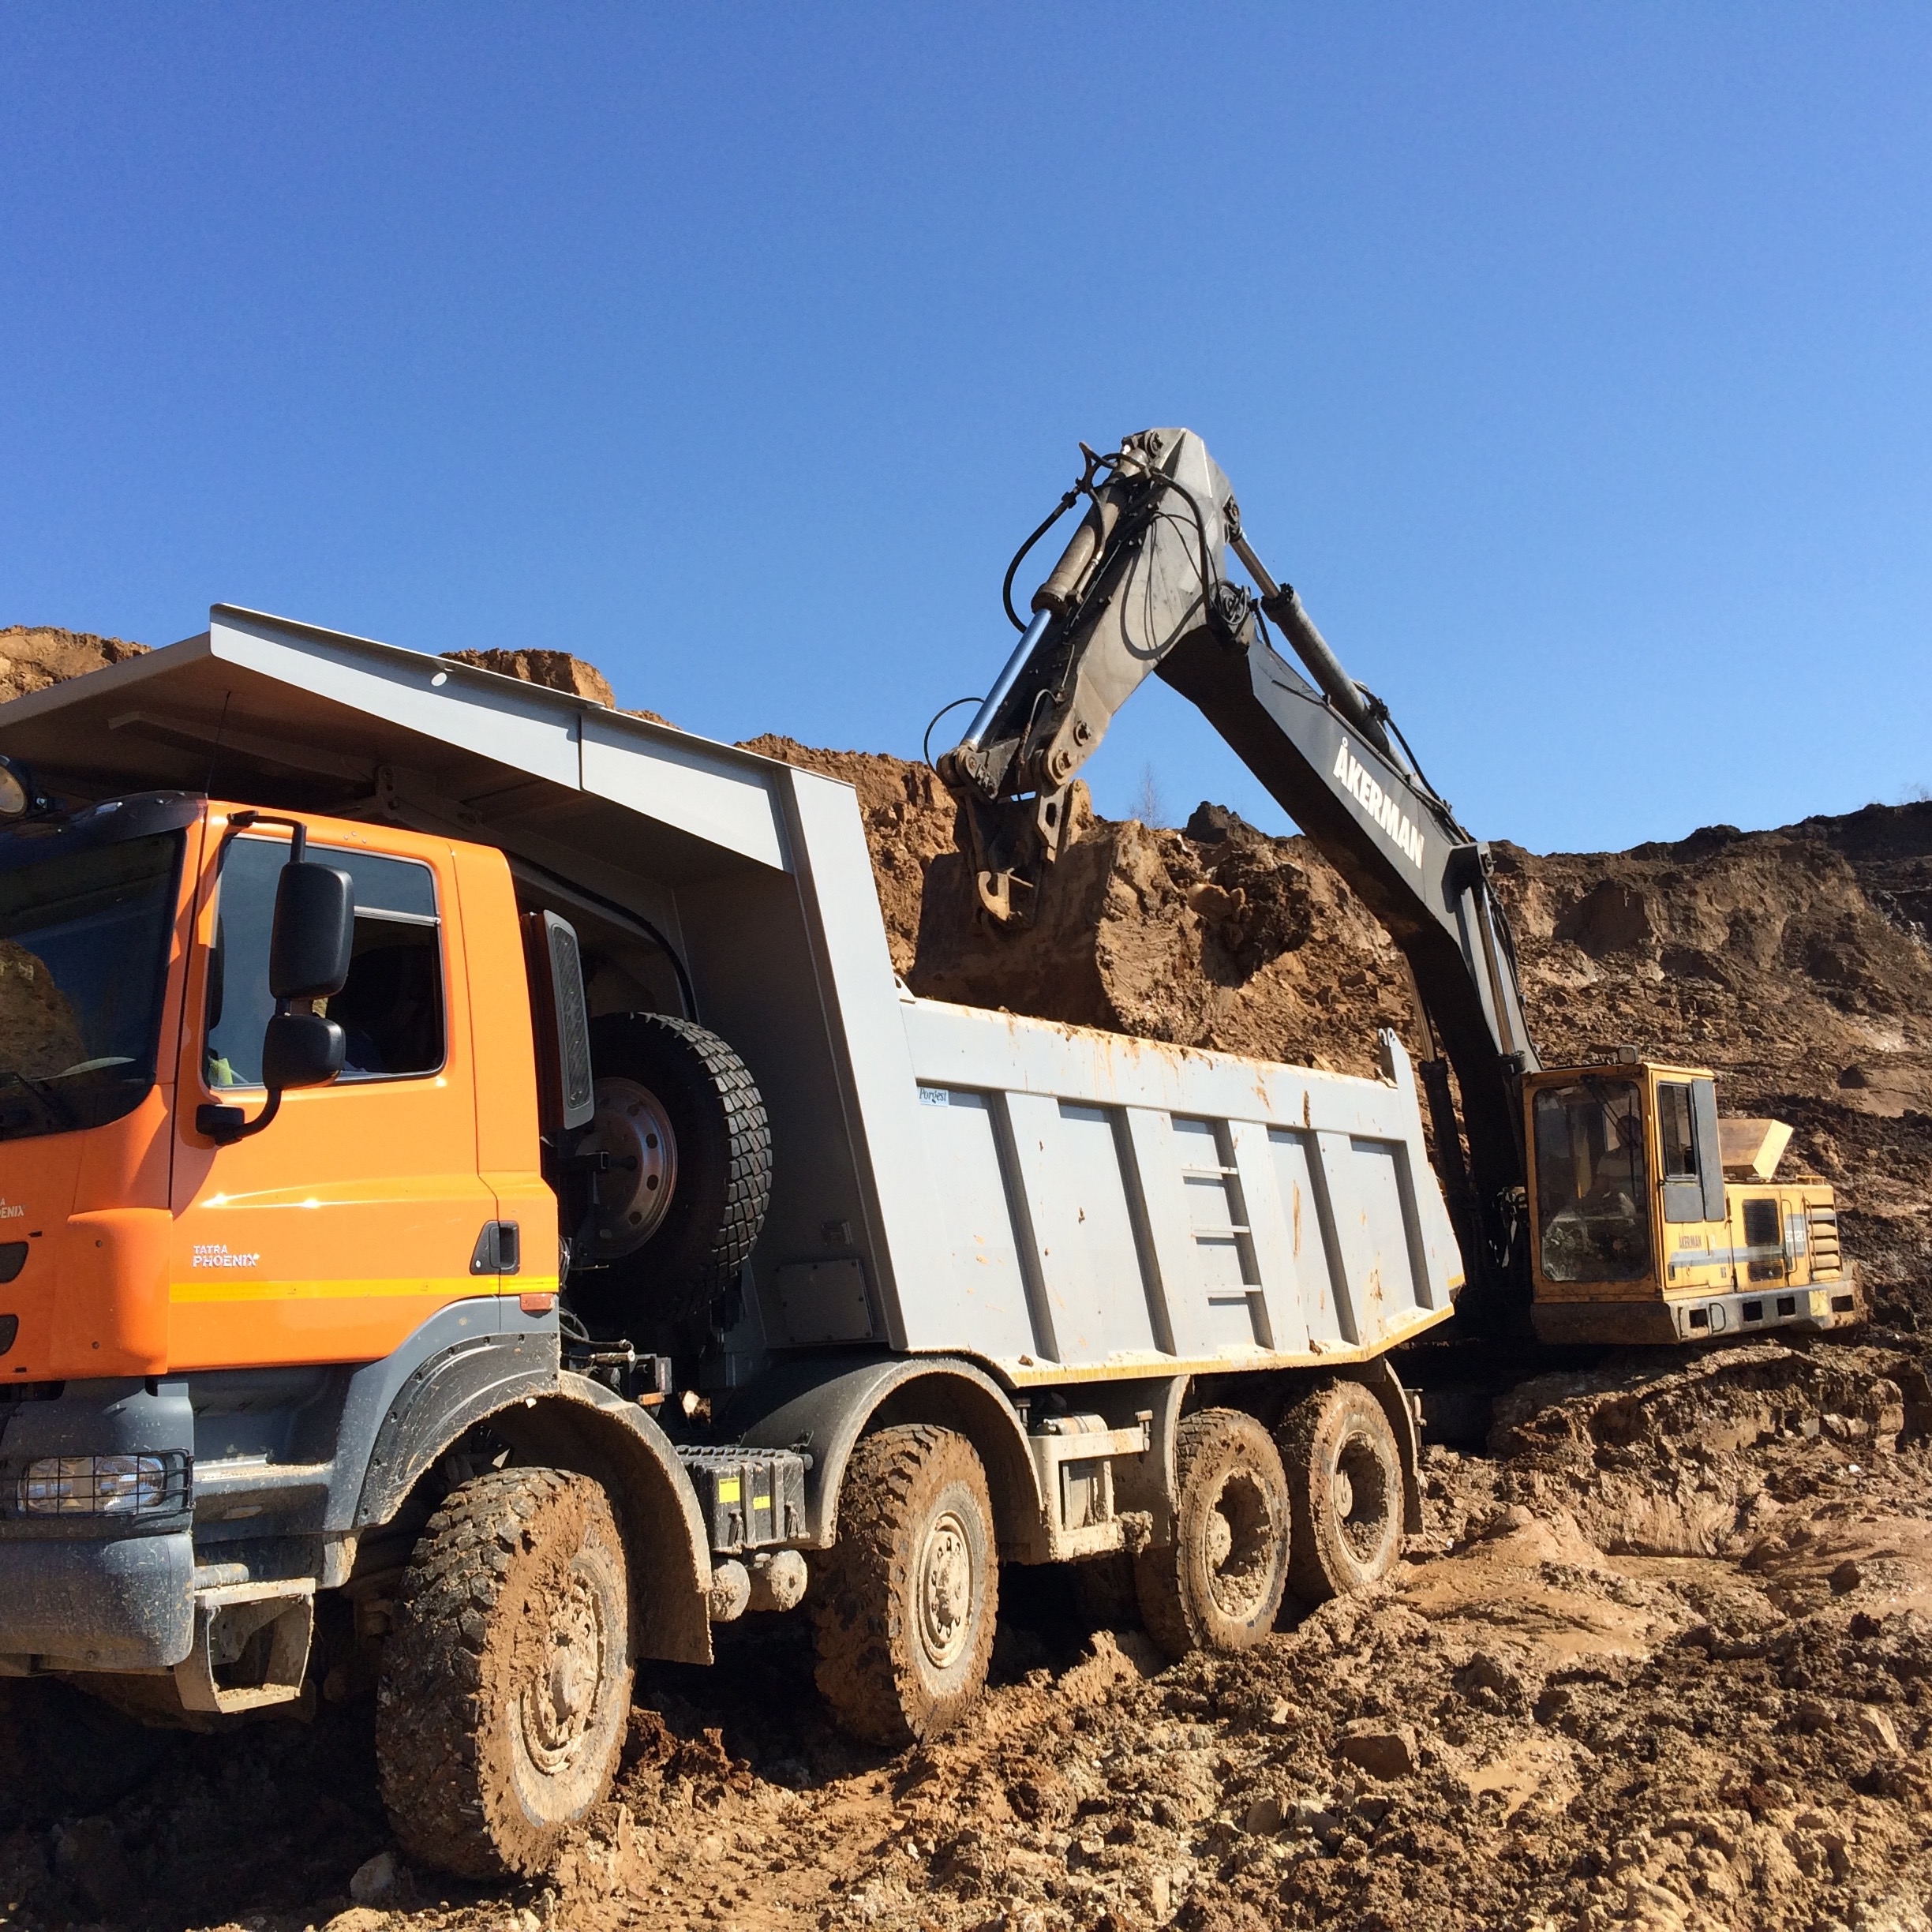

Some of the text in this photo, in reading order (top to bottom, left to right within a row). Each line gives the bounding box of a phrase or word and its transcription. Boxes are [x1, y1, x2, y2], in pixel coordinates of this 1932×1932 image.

[1333, 736, 1424, 869] ÅKERMAN
[0, 1205, 24, 1219] ENIX
[193, 1244, 228, 1254] TATRA
[193, 1253, 256, 1267] PHOENIX
